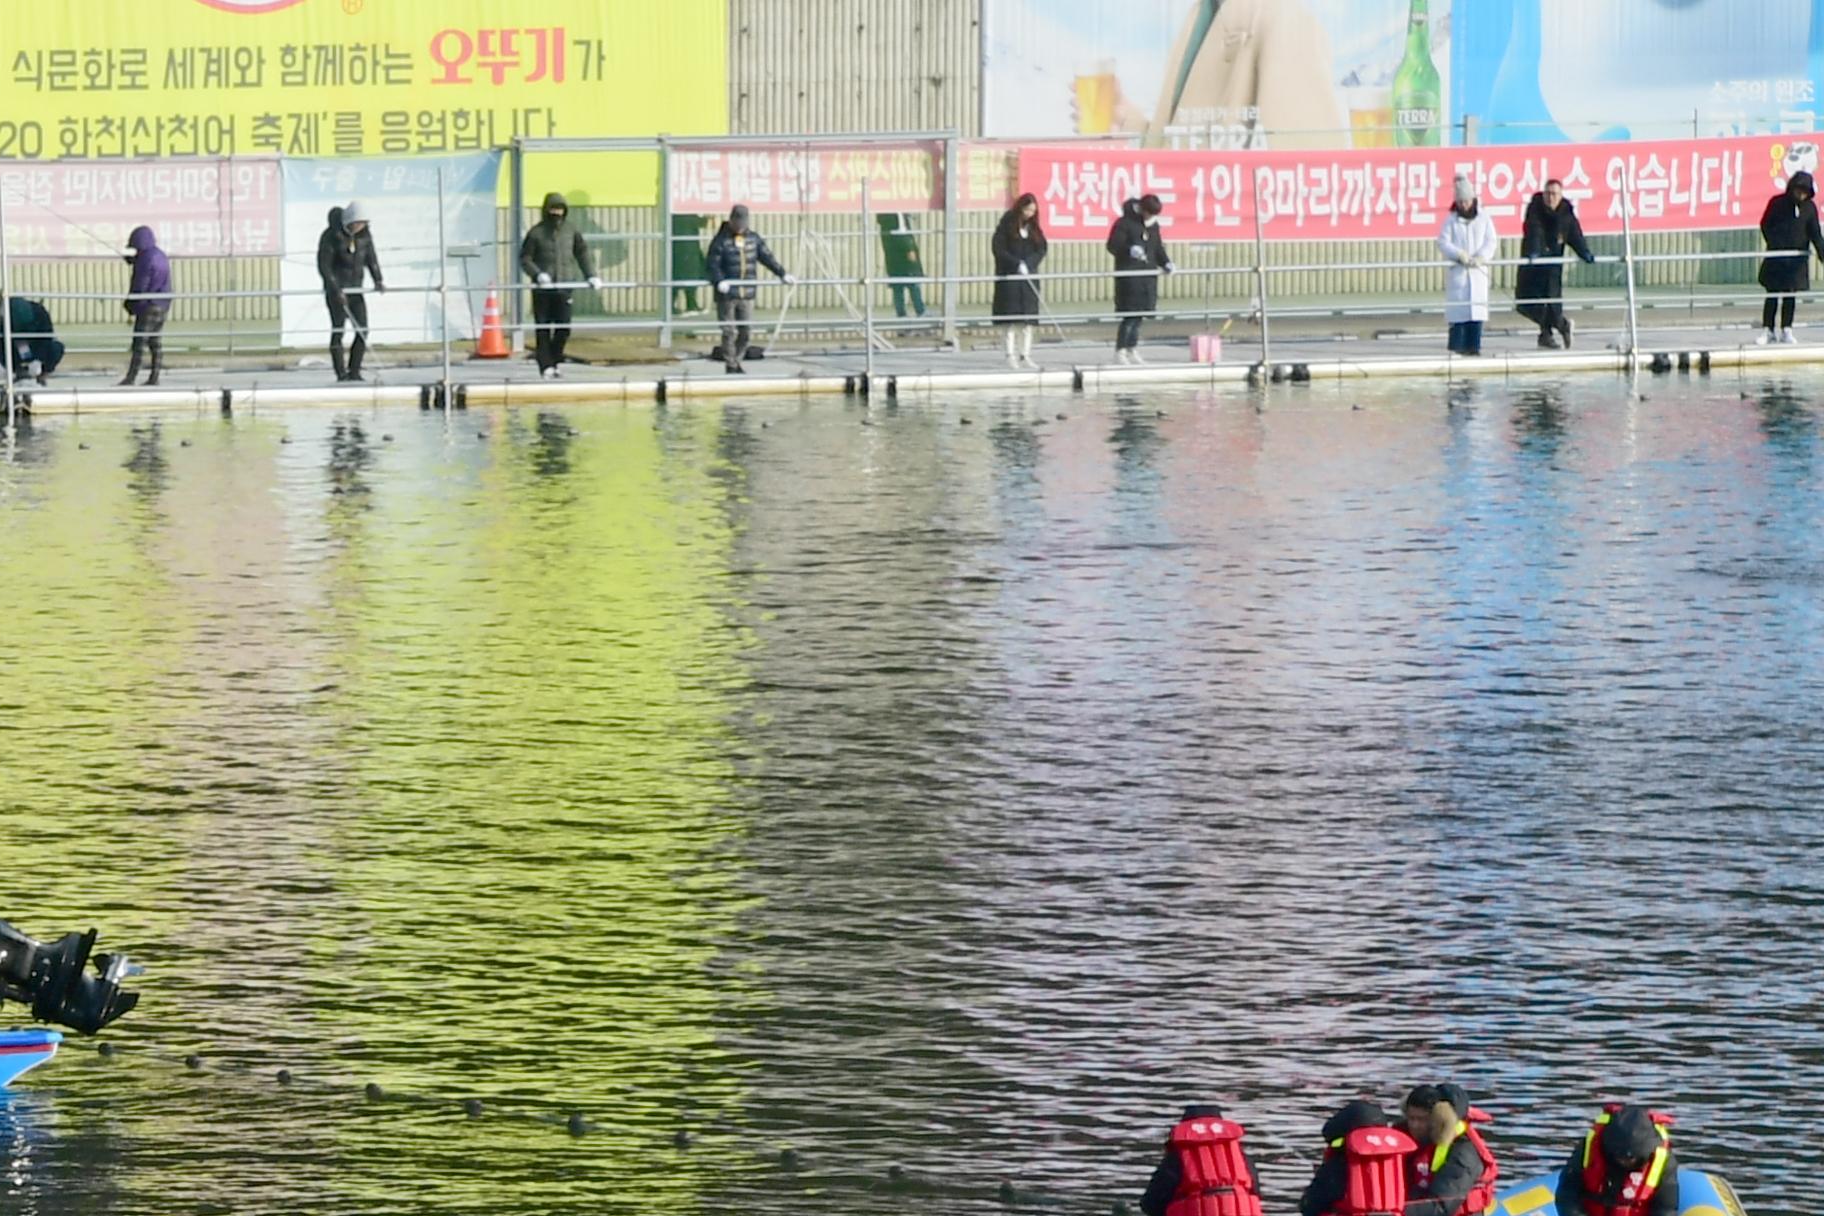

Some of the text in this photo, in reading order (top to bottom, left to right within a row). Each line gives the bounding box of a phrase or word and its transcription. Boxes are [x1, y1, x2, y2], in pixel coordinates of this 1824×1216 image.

[12, 48, 149, 92] 식문화로
[163, 46, 266, 89] 세계와
[279, 43, 414, 87] 함께하는
[1709, 79, 1815, 104] 소주의 원조
[57, 112, 235, 159] 화천산천어
[251, 111, 365, 155] 축제'를
[379, 107, 557, 153] 응원합니다
[1397, 108, 1437, 125] TERRA
[1043, 161, 1176, 227] 산천어는
[1190, 163, 1242, 227] 1인
[1256, 160, 1440, 228] 3마리까지만
[1561, 156, 1594, 223] 수
[1605, 149, 1743, 220] 있습니다!
